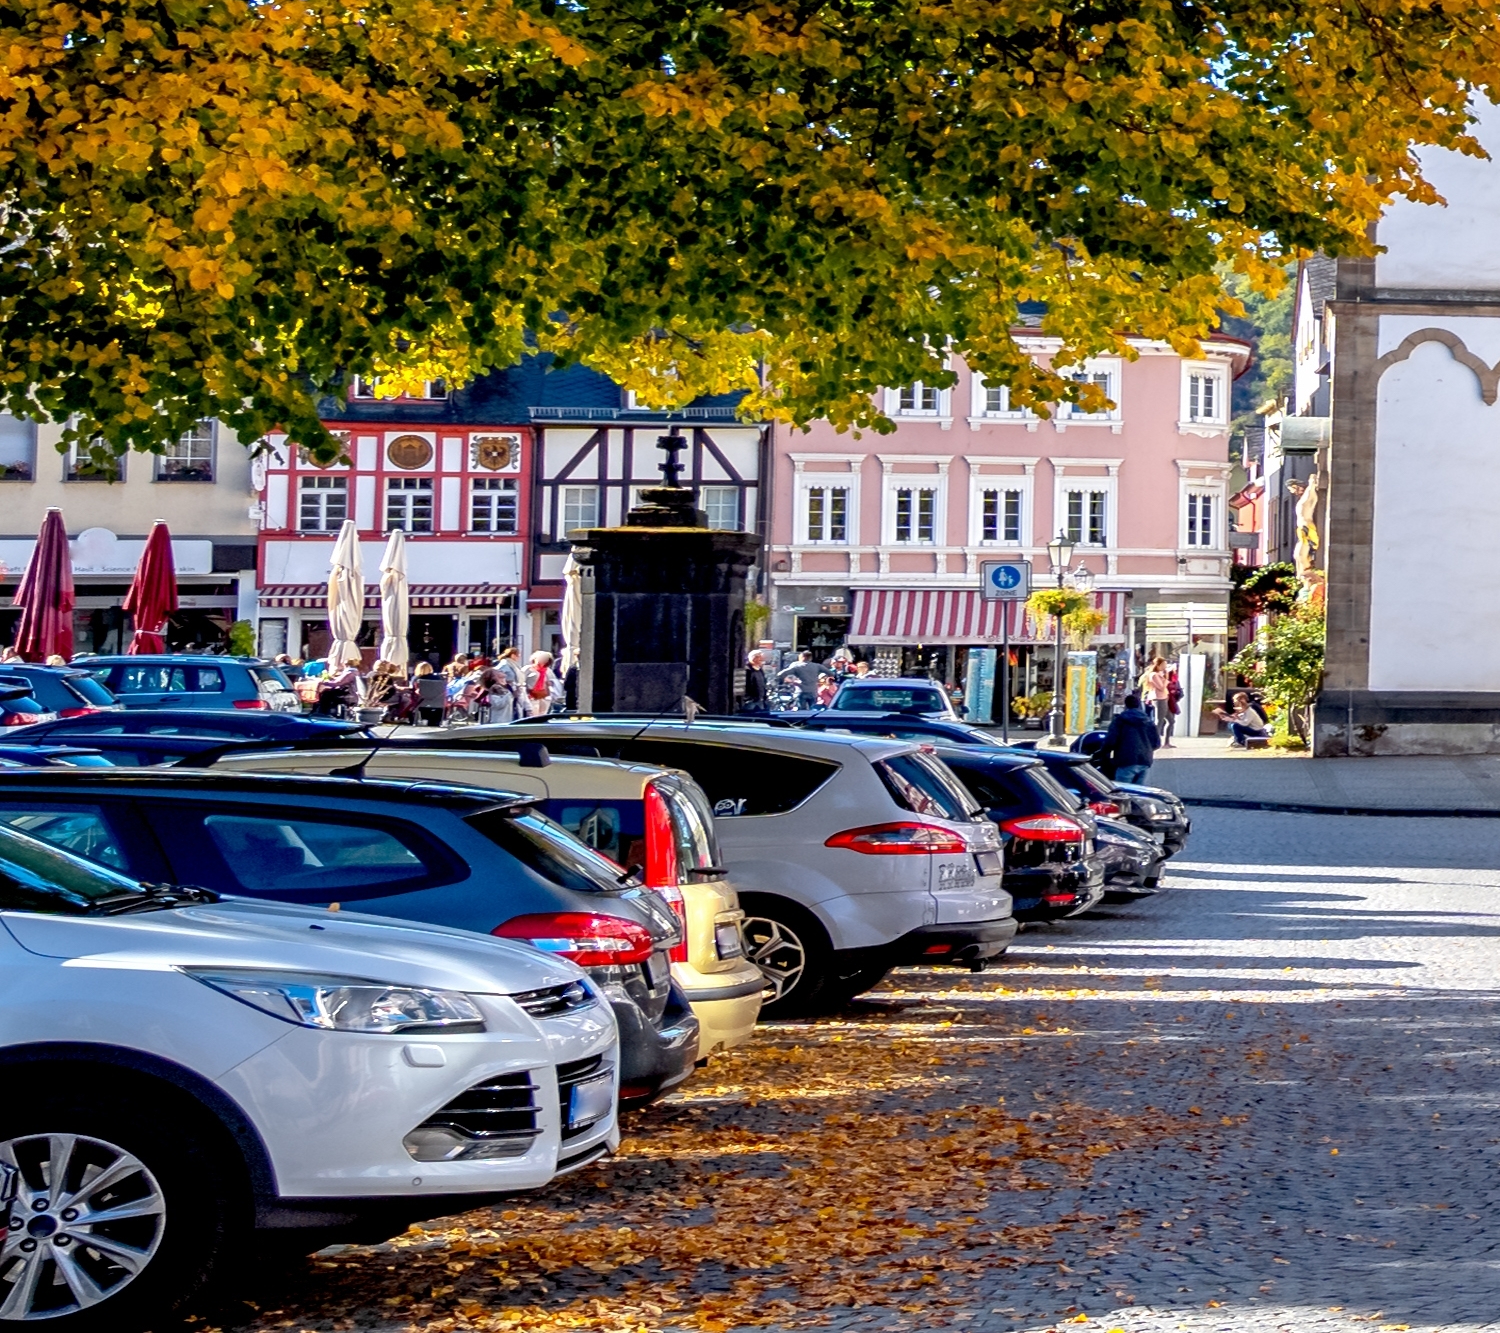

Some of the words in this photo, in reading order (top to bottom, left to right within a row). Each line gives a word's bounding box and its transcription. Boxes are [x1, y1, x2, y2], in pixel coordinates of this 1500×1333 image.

[101, 565, 131, 573] Science
[179, 565, 195, 573] skin
[995, 589, 1018, 597] ZONE
